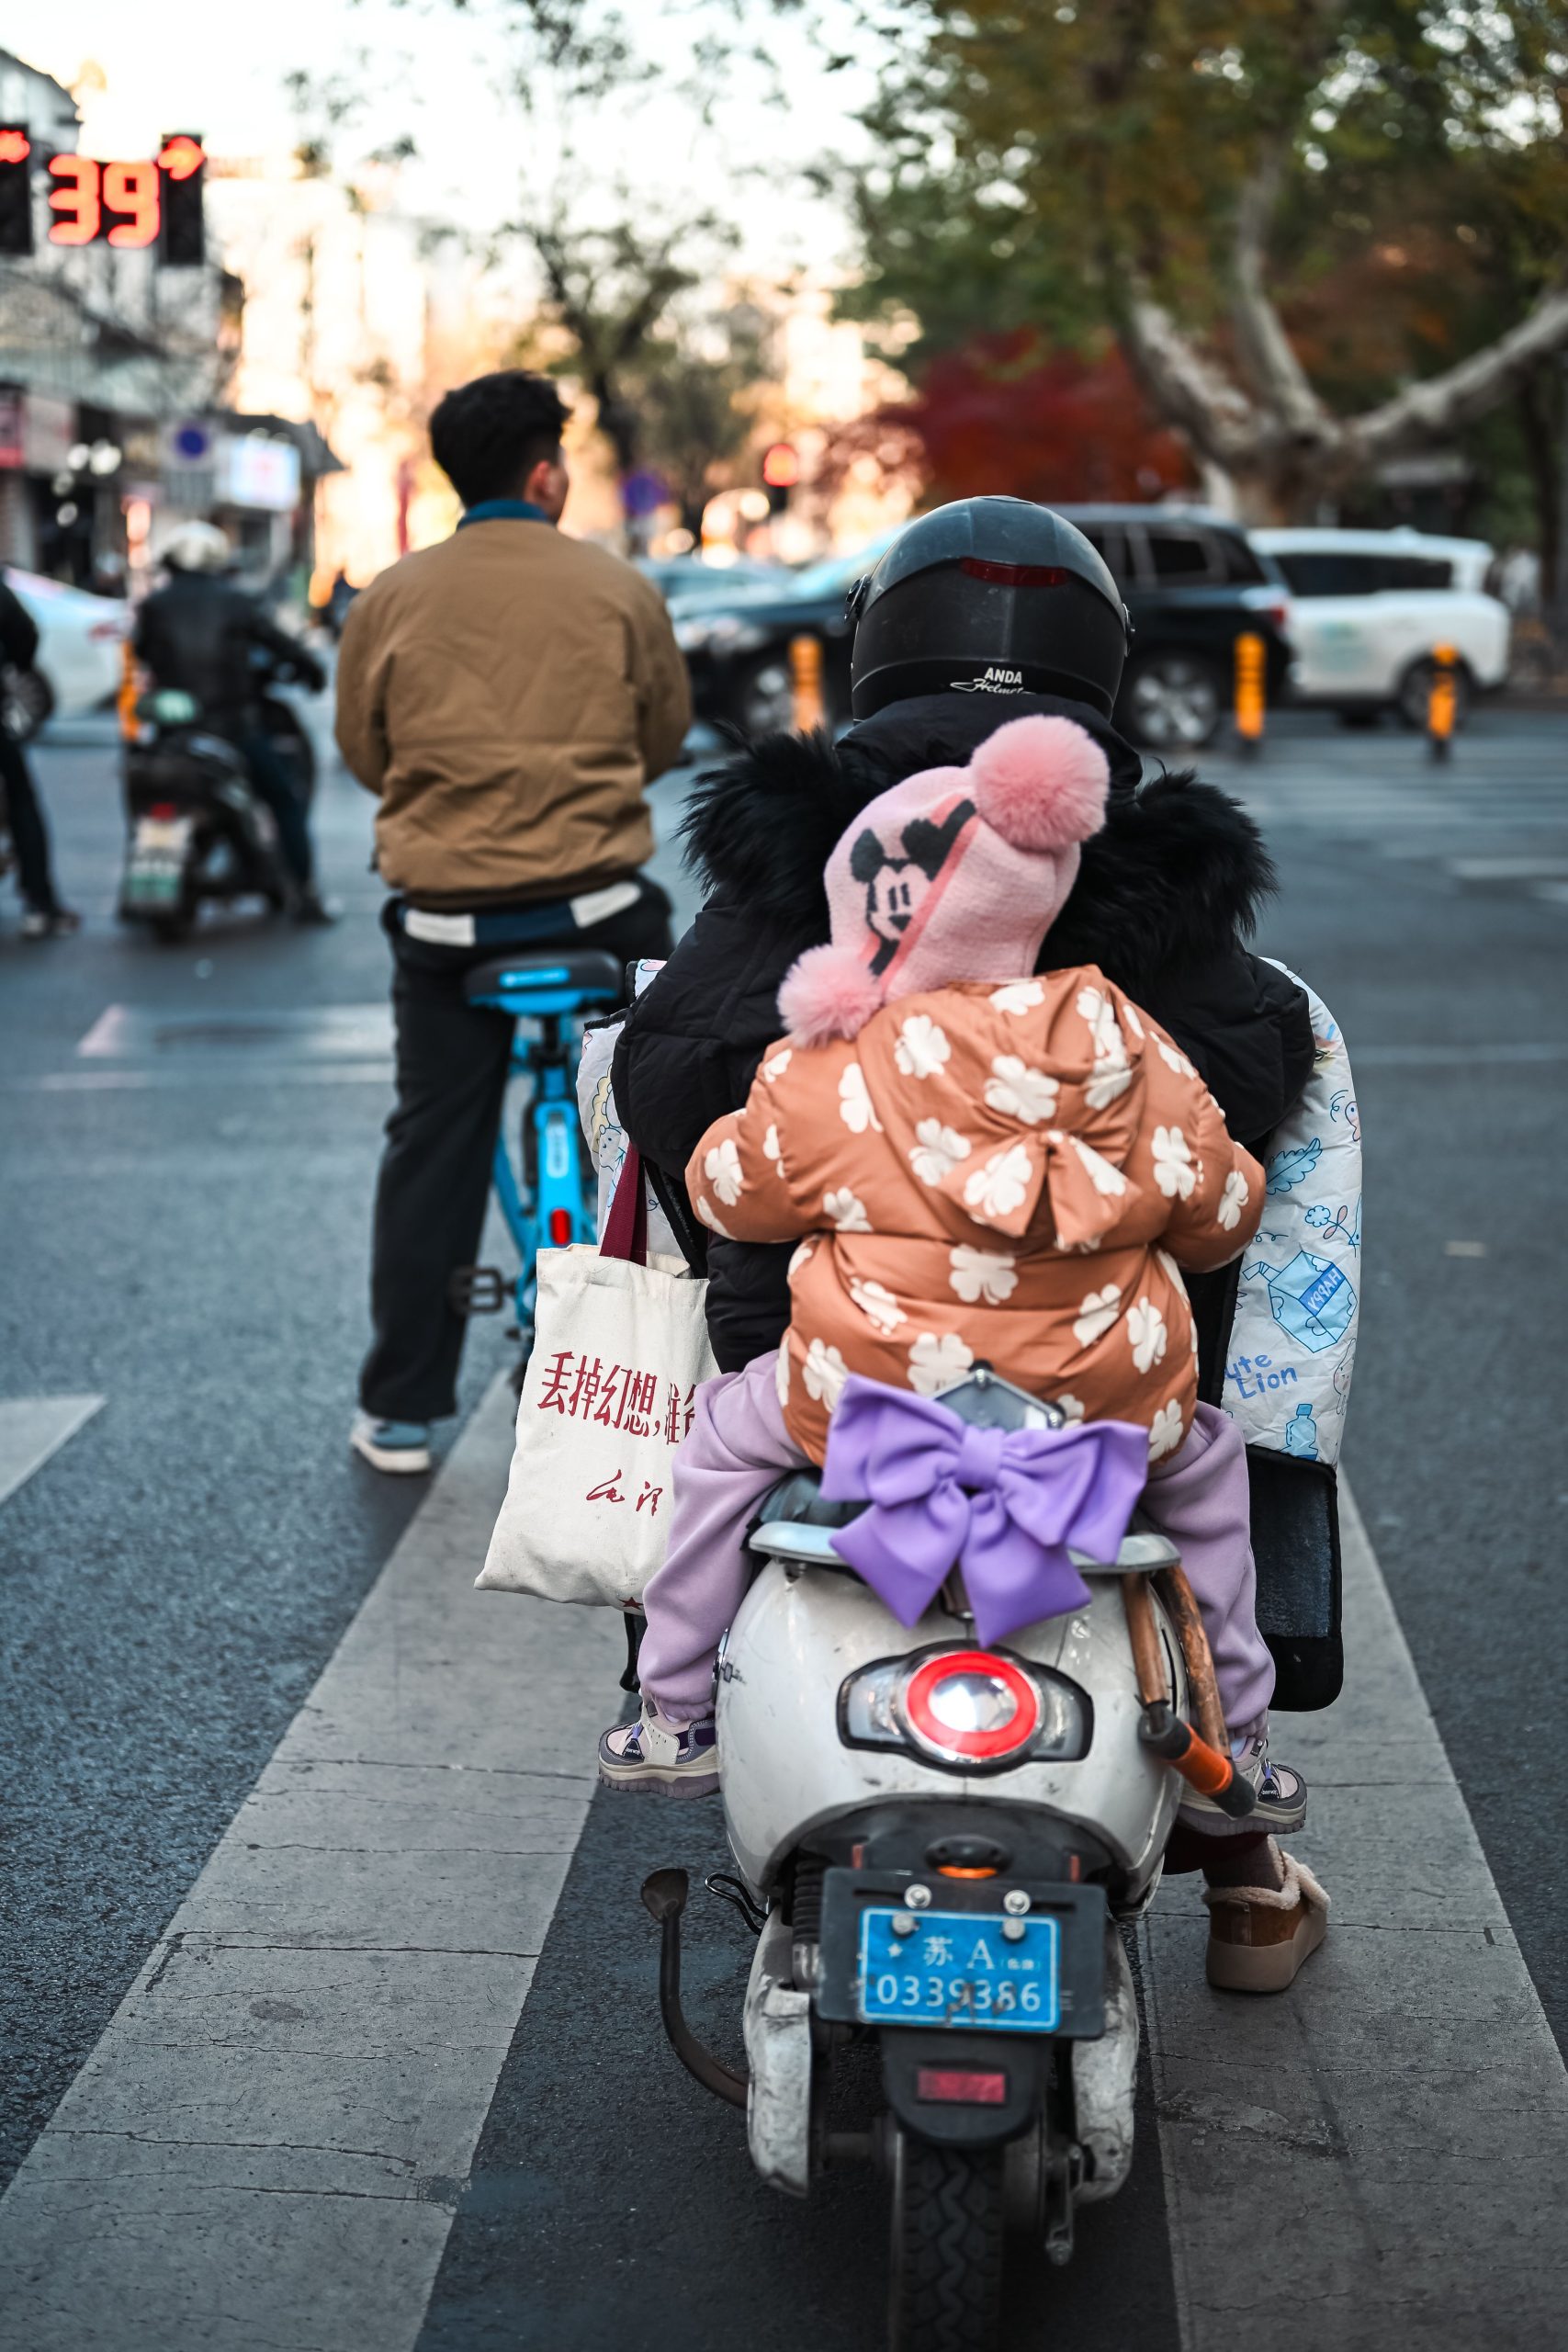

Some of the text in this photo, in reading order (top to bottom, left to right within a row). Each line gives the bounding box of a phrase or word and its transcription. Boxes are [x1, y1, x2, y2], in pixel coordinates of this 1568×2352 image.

[49, 153, 161, 249] 39
[950, 678, 1036, 695] Helmet
[984, 667, 1022, 684] ANDA
[1236, 1367, 1298, 1399] Lion
[923, 1936, 953, 1967] 苏
[966, 1939, 996, 1970] A
